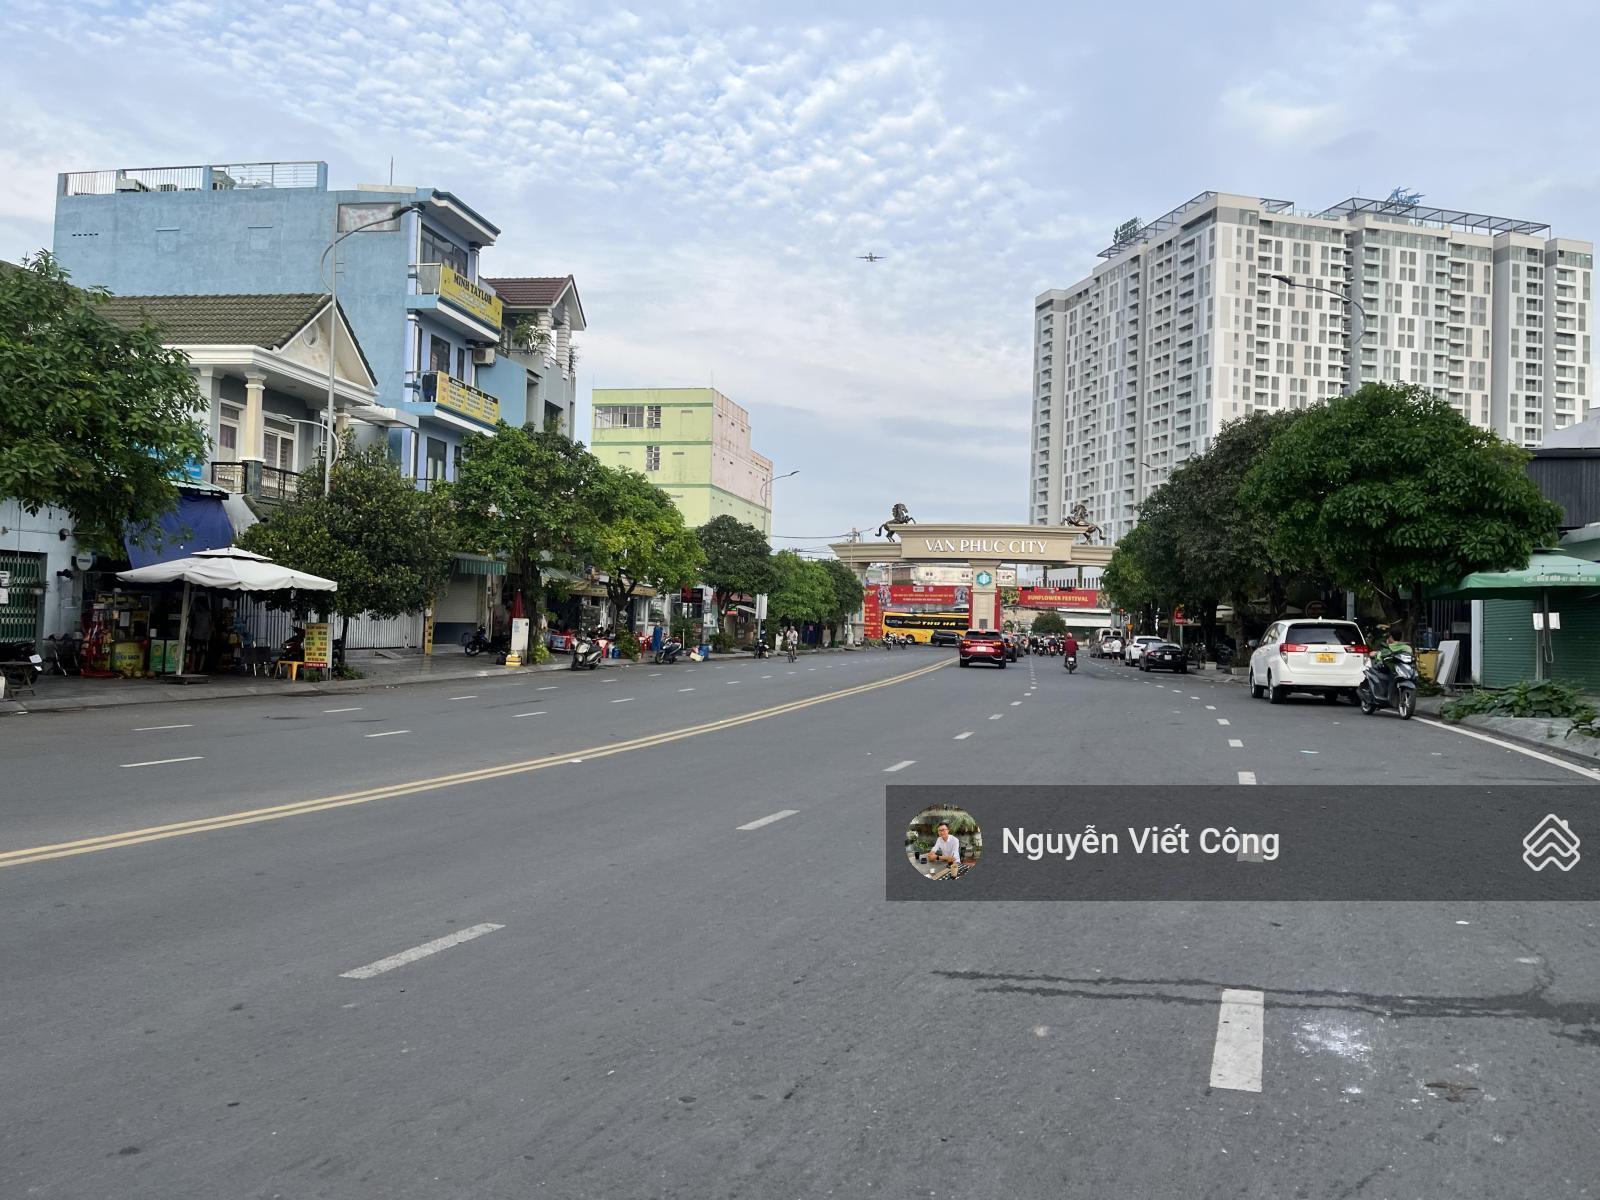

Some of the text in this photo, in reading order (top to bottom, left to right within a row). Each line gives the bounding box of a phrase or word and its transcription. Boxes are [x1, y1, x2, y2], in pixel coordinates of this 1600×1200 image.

[454, 272, 470, 291] MINH
[471, 284, 492, 305] TAYLOR
[925, 539, 1047, 554] VAN PHUC CITY
